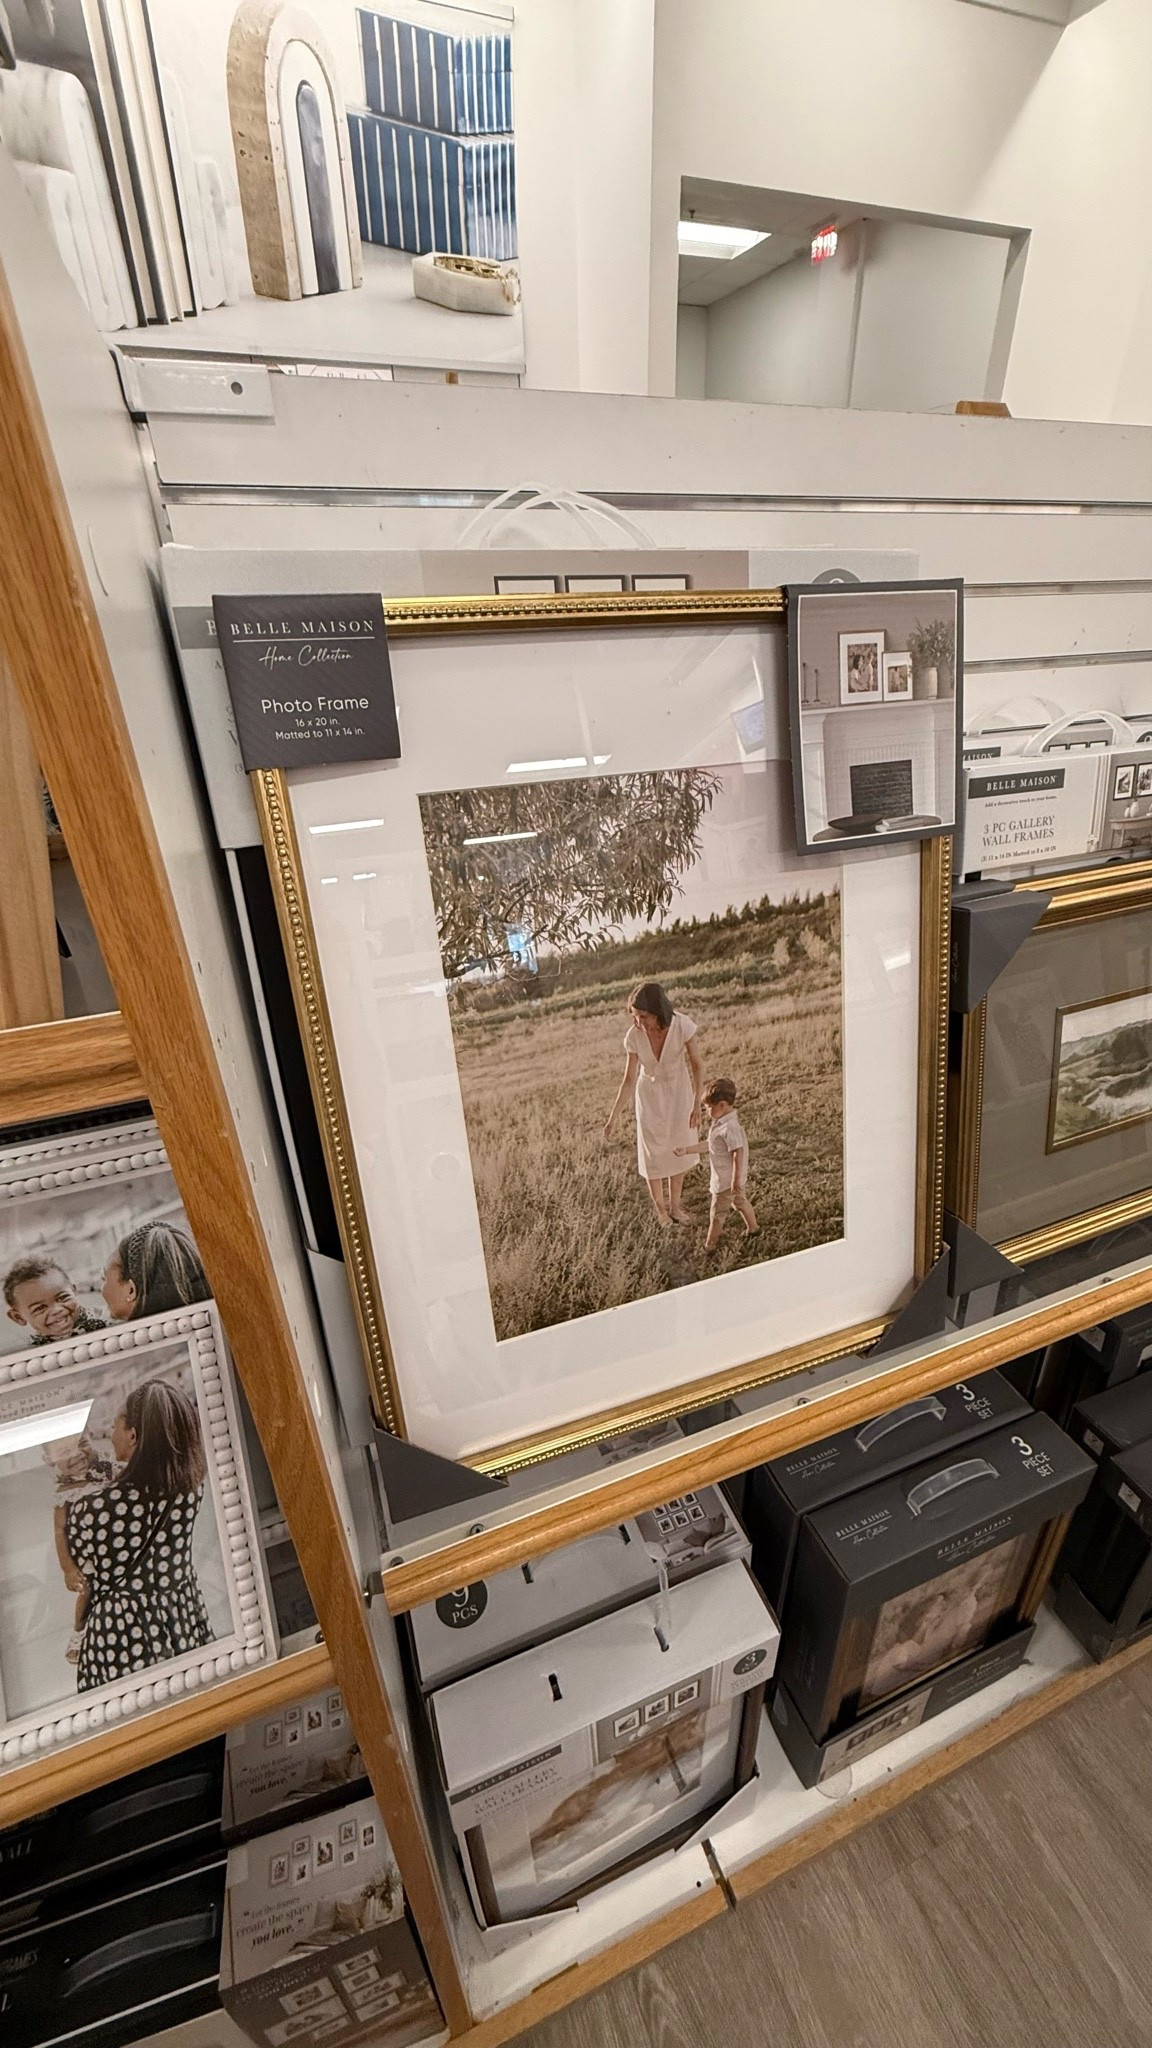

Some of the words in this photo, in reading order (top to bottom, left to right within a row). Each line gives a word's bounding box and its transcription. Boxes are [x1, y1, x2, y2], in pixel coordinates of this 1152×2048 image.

[230, 621, 291, 636] BELLE
[301, 620, 374, 634] MAISON
[259, 646, 294, 670] Home
[297, 644, 354, 667] Collection
[261, 698, 313, 714] Photo
[317, 696, 369, 712] Frame
[295, 718, 305, 727] 16
[315, 717, 327, 726] 20
[329, 716, 340, 725] in.
[275, 730, 311, 740] Matted
[313, 729, 323, 738] to
[326, 728, 333, 737] 11
[343, 727, 353, 736] 14
[986, 780, 1016, 791] BELLE
[1020, 775, 1057, 787] MAISON
[984, 824, 989, 834] 3
[993, 822, 1006, 833] PC
[1008, 815, 1055, 831] GALLERY
[983, 834, 1011, 847] WALL
[1014, 828, 1055, 843] FRAMES
[955, 1383, 975, 1401] 3
[964, 1397, 992, 1413] PIECE
[977, 1407, 994, 1420] SET
[1010, 1435, 1033, 1456] 3
[1022, 1451, 1050, 1470] PIECE
[1036, 1463, 1054, 1477] SET
[452, 1586, 469, 1608] 9
[452, 1604, 478, 1623] PCS
[251, 1933, 270, 1950] you
